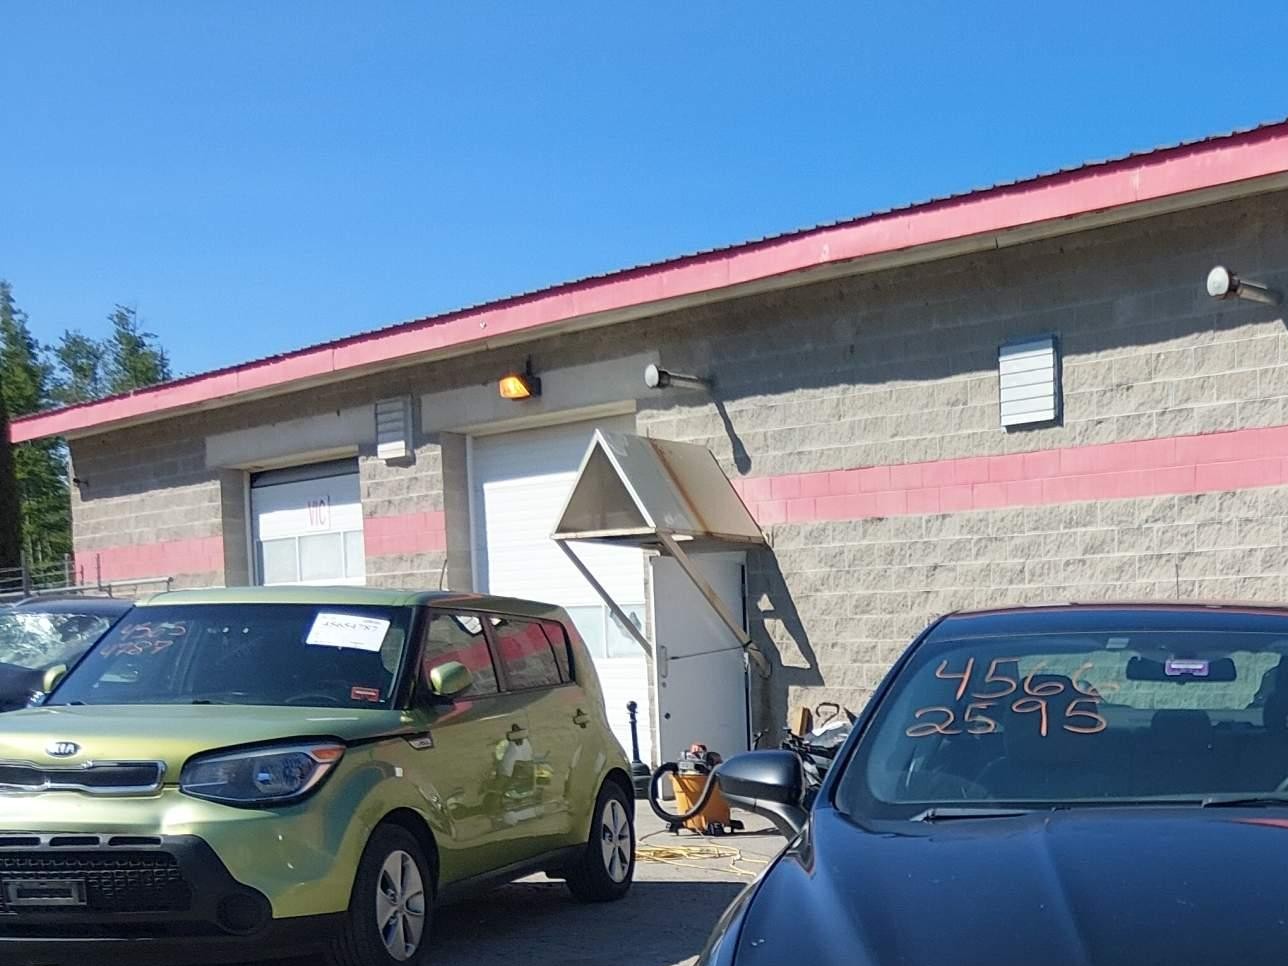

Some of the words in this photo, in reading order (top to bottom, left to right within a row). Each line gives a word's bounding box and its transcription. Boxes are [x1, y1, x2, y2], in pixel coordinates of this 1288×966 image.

[935, 656, 1120, 700] 4566
[906, 696, 1108, 737] 2595
[48, 743, 77, 755] KIA
